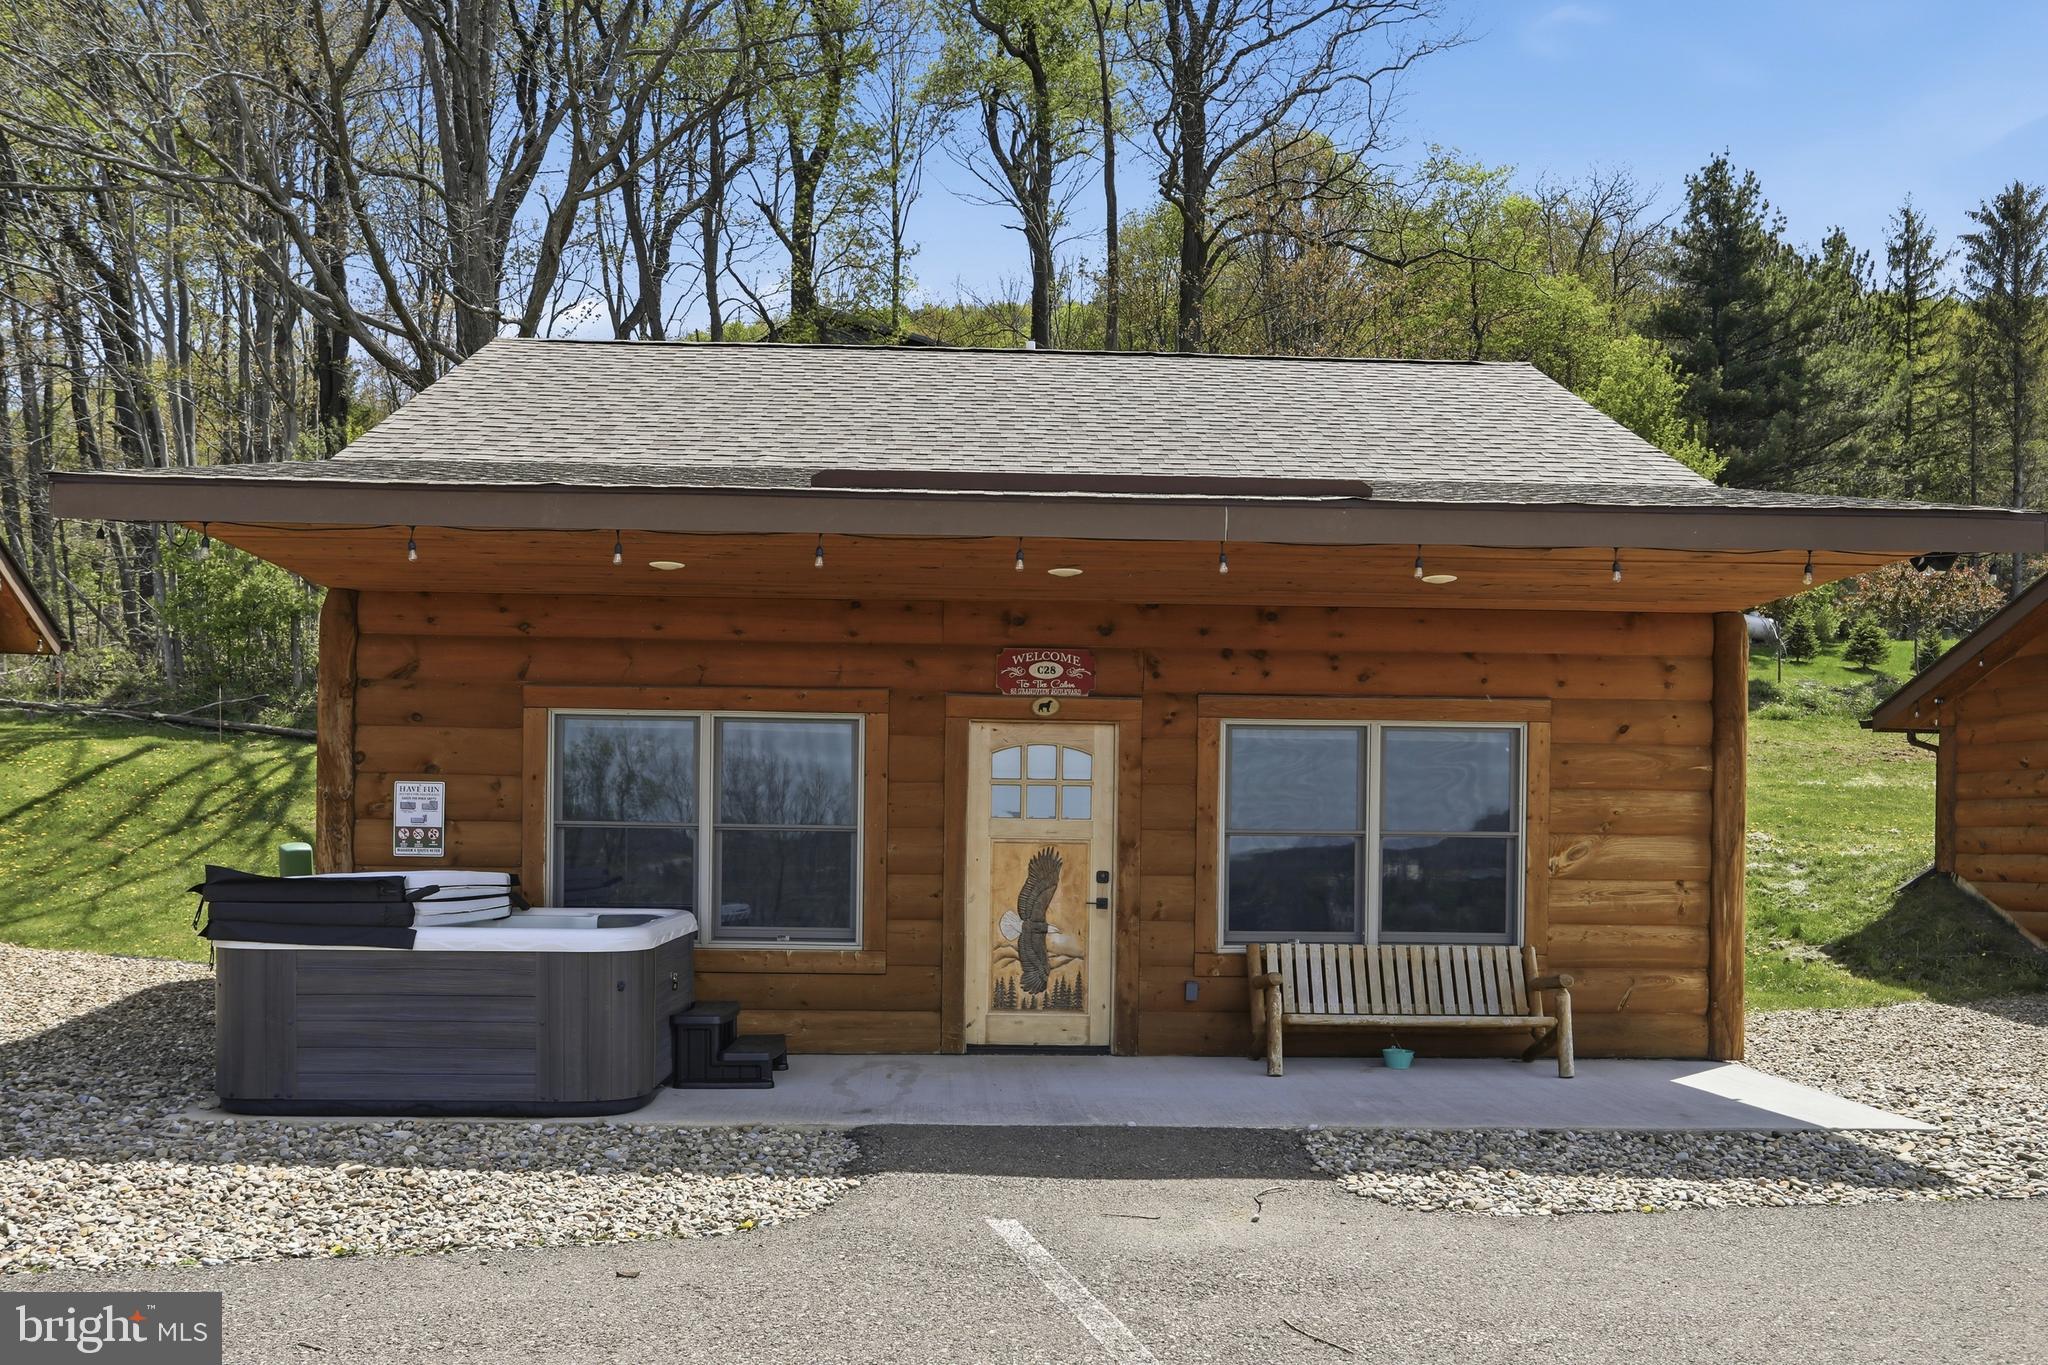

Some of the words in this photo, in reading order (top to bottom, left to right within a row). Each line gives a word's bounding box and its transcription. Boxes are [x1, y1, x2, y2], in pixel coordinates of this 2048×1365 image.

[1012, 651, 1081, 667] WELCOME
[1036, 665, 1057, 675] C28
[1016, 679, 1030, 688] To
[1032, 679, 1048, 689] The
[1050, 679, 1076, 689] Cabin
[1051, 688, 1082, 696] BOULEVARD
[399, 785, 420, 793] HAVE
